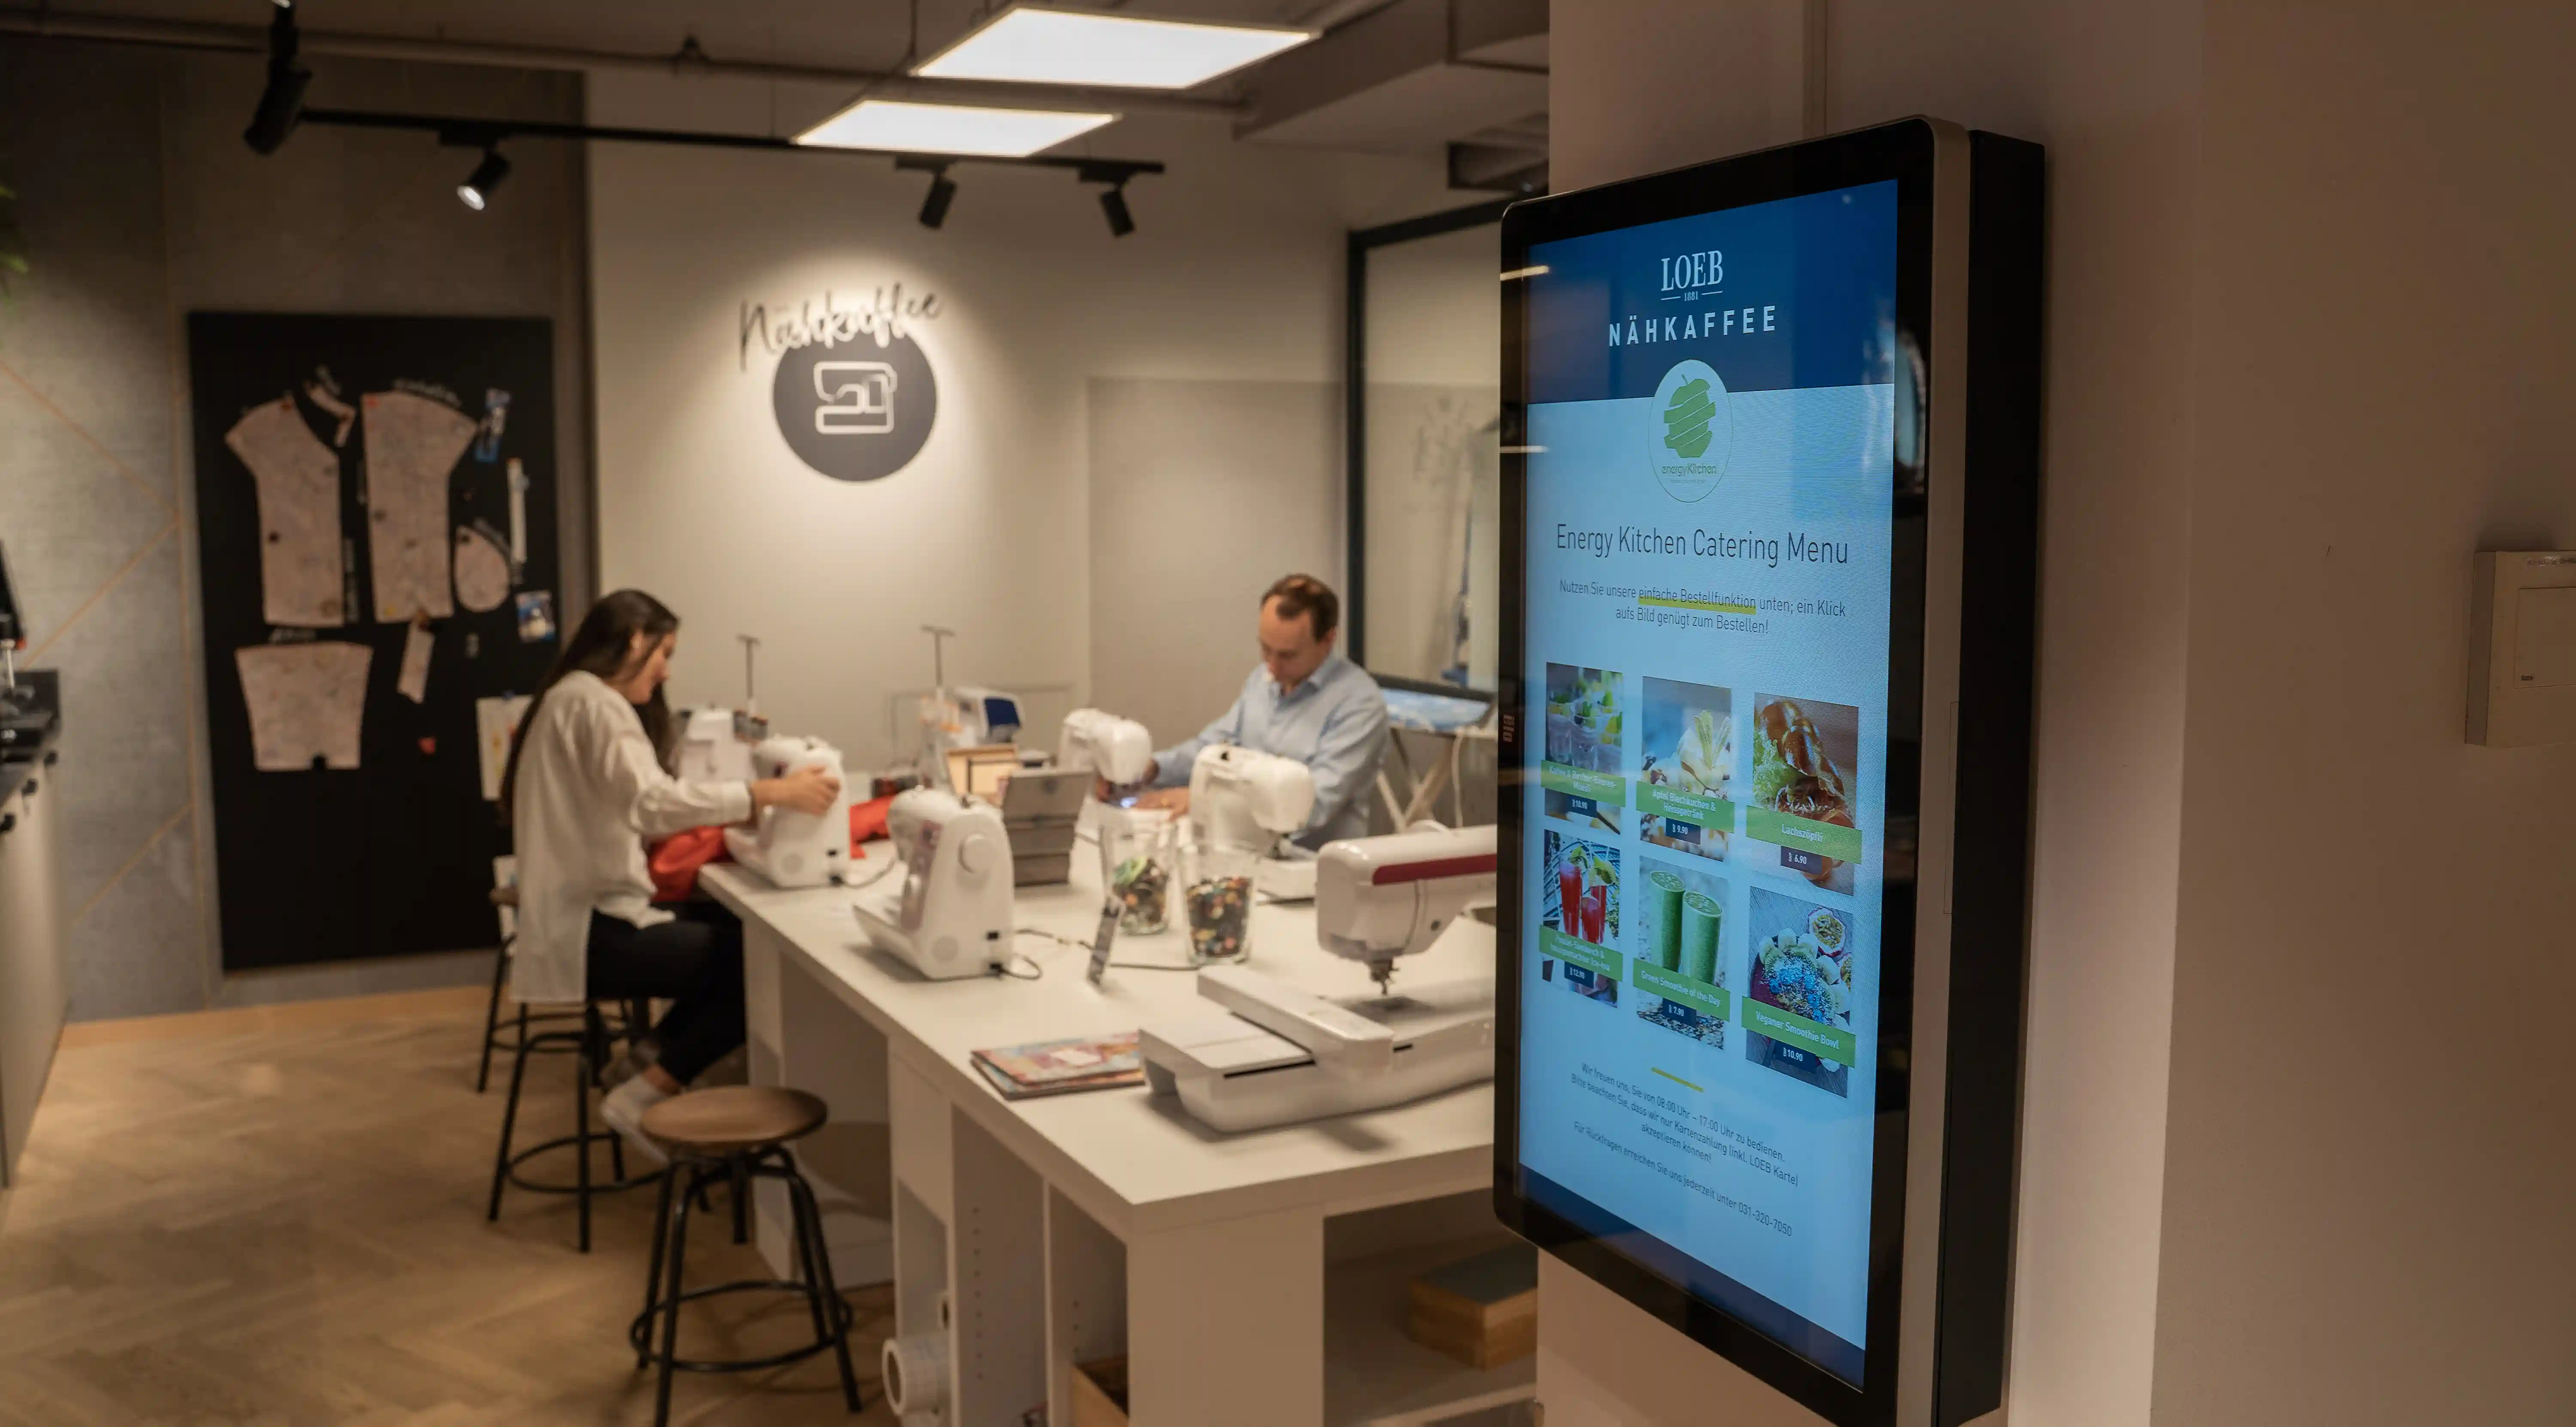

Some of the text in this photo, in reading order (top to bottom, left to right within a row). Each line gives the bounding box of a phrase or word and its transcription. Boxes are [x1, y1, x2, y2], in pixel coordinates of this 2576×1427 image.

[1661, 250, 1723, 291] LOEB
[1684, 291, 1698, 301] 1881
[1609, 305, 1775, 347] NÄHKAFFEE
[1662, 463, 1716, 477] energyKitchen
[1557, 524, 1847, 568] Energy Kitchen Catering Menu
[1560, 580, 1846, 617] Nutzen Sie unsere einfache Bestellfunktion unten; ein Klick
[1616, 607, 1769, 634] aufs Bild genügt zum Bestellen!
[1653, 789, 1668, 800] Apfel
[1710, 802, 1716, 811] &
[1663, 803, 1704, 820] Heissgetränk
[1677, 825, 1688, 835] 9.90
[1794, 854, 1807, 865] 6.90
[1640, 970, 1659, 984] Green
[1697, 989, 1707, 1001] the
[1709, 994, 1721, 1008] Day
[1673, 1006, 1684, 1017] 7.90
[1756, 1011, 1839, 1049] Veganer Smoothie Bowl
[1787, 1049, 1803, 1062] 10.90
[1571, 1074, 1586, 1088] Bitte
[1588, 1081, 1616, 1103] beachten
[1618, 1094, 1630, 1110] Sie,
[1631, 1101, 1647, 1117] dass
[1649, 1111, 1659, 1122] wir
[1661, 1116, 1672, 1128] nur
[1674, 1119, 1727, 1156] Kartenzahlung
[1750, 1155, 1771, 1173] LOEB
[1774, 1164, 1798, 1187] Karte)
[1582, 1062, 1592, 1075] Wir
[1595, 1067, 1615, 1086] freuen
[1616, 1079, 1630, 1093] uns,
[1632, 1084, 1642, 1098] Sie
[1644, 1092, 1655, 1105] von
[1657, 1095, 1676, 1113] 08:00
[1677, 1105, 1690, 1120] Uhr
[1699, 1115, 1718, 1132] 17:00
[1720, 1124, 1734, 1139] Uhr
[1736, 1133, 1745, 1145] zu
[1747, 1136, 1785, 1163] bedienen.
[1641, 1123, 1711, 1163] akzeptieren können!
[1574, 1121, 1792, 1237] Für Rückfragen erreichen Sie uns jederzeit unter 031-320-7050
